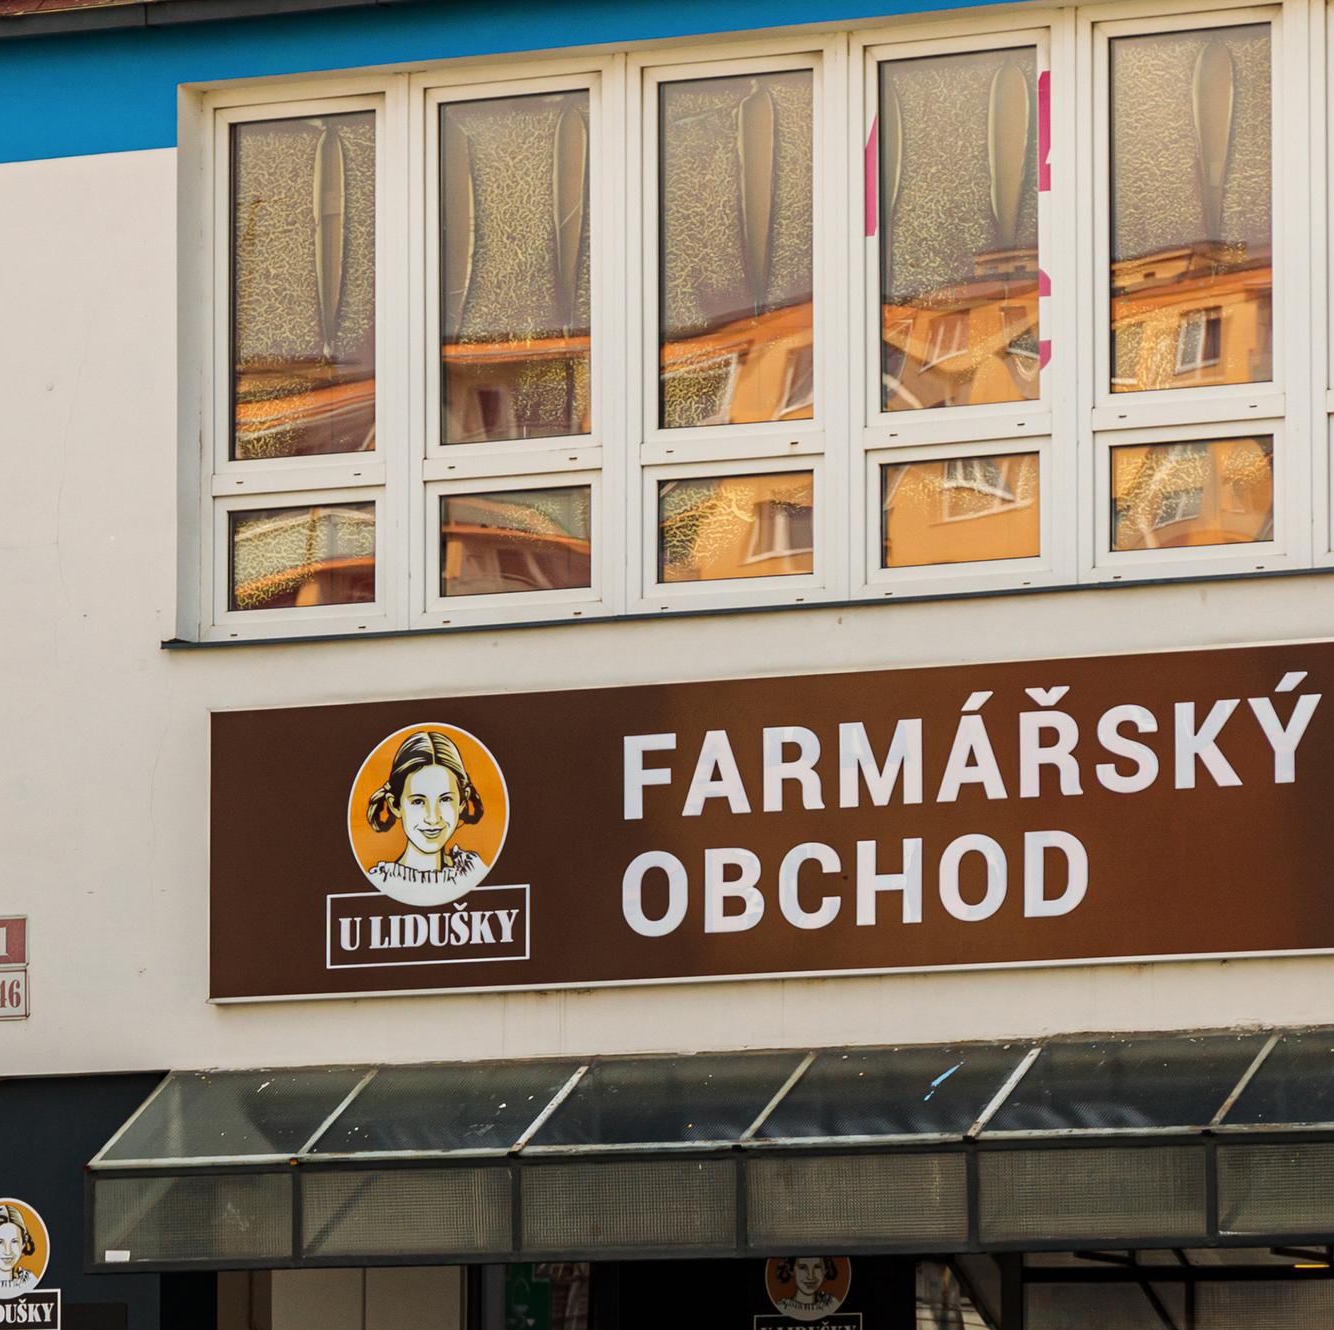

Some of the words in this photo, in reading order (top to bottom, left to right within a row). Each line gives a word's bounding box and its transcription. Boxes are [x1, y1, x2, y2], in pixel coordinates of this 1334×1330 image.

[622, 671, 1323, 821] FARMÁŘSKÝ
[338, 917, 363, 951] U
[368, 902, 520, 949] LIDUŠKY
[622, 829, 1090, 938] OBCHOD
